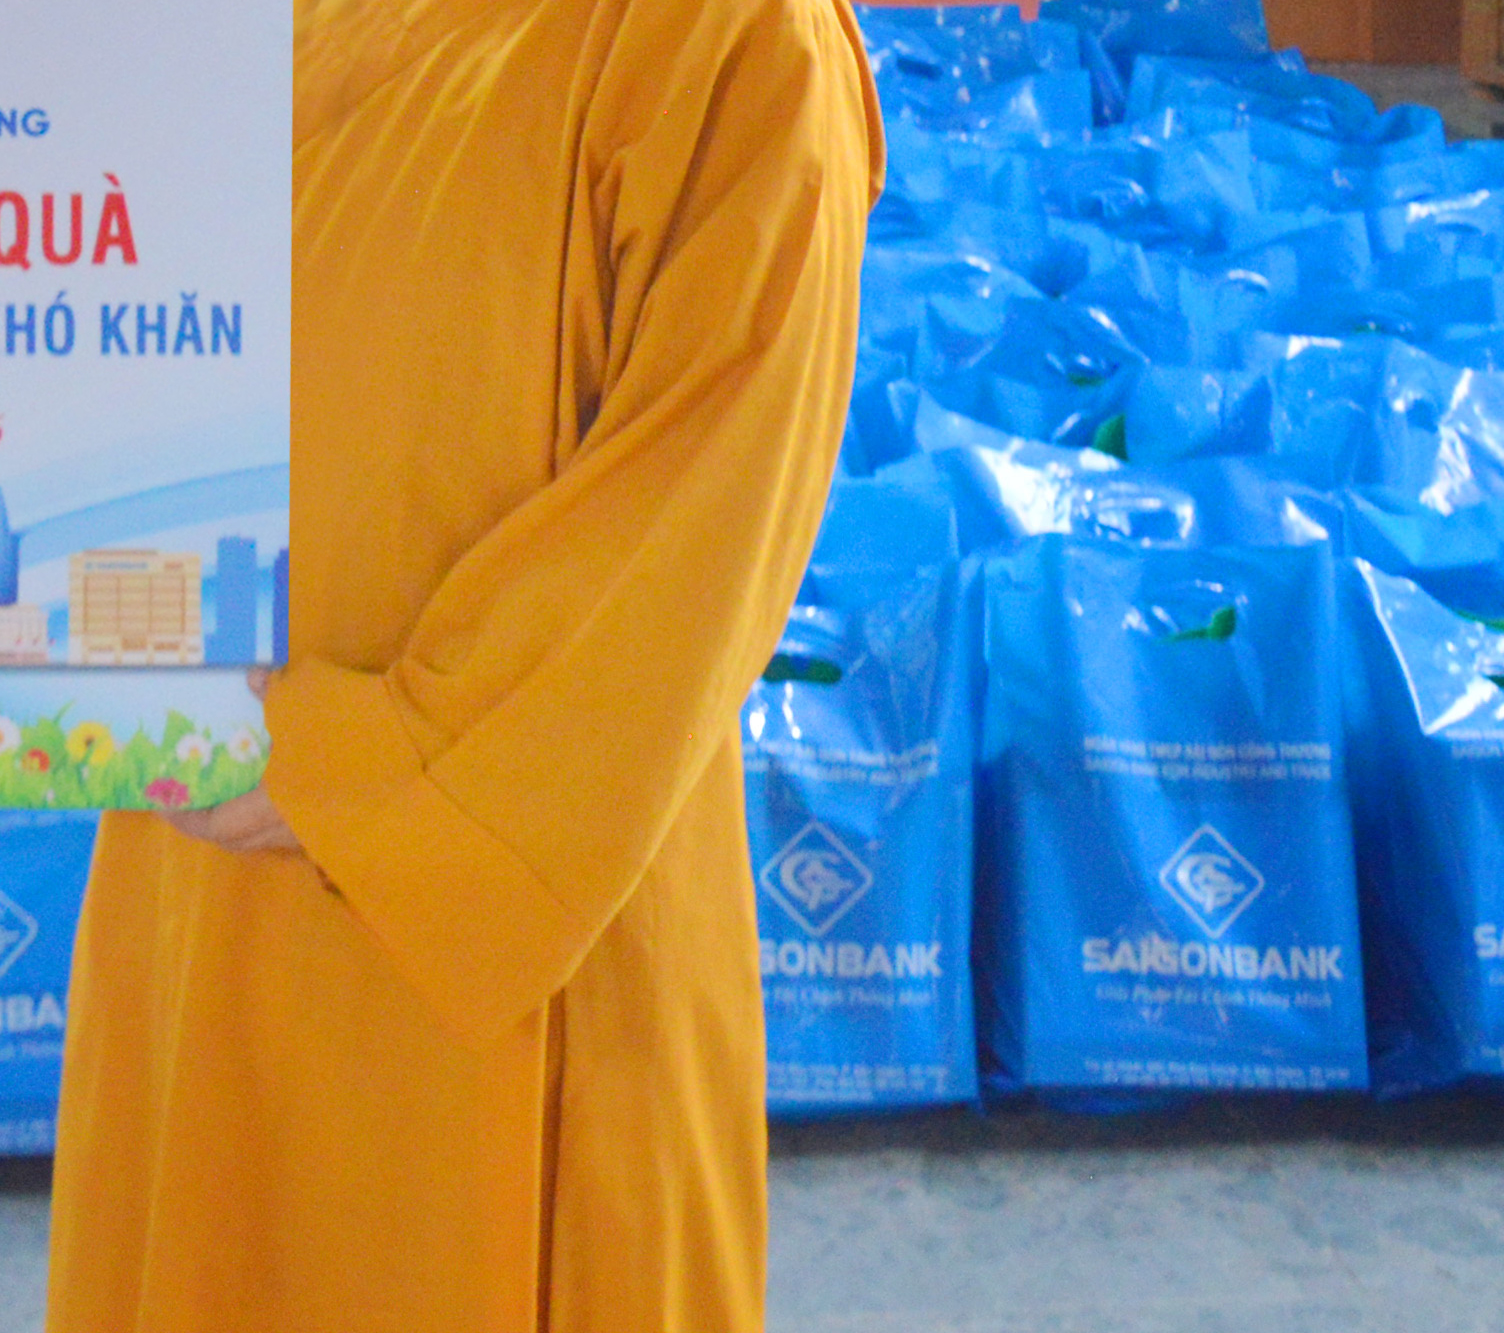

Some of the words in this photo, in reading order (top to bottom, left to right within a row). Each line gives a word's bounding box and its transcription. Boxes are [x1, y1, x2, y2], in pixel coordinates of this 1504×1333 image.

[100, 292, 243, 356] KHĂN
[759, 939, 941, 979] GONBANK
[1082, 934, 1343, 980] SAIGONBANK
